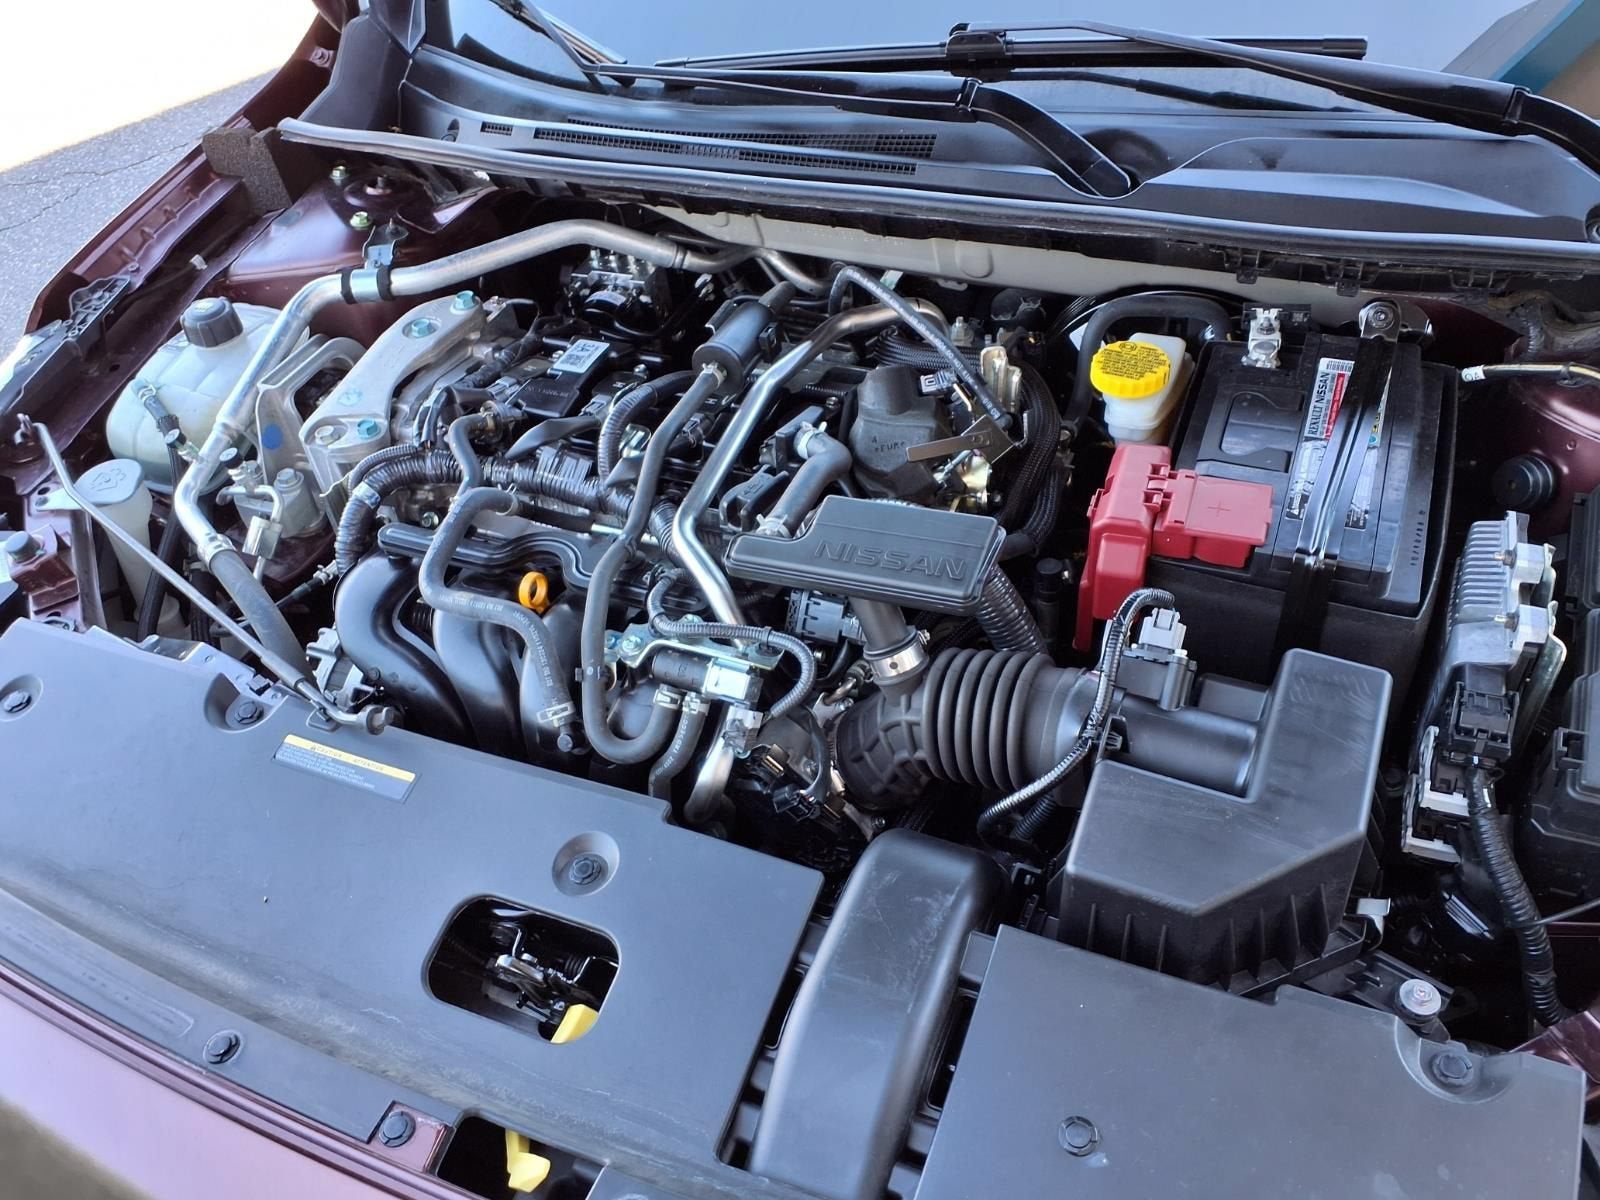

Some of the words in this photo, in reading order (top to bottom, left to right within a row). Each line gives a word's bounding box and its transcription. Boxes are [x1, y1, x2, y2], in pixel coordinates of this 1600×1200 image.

[1315, 372, 1330, 404] NISSAN
[1308, 405, 1323, 435] RENAULT
[814, 540, 968, 581] NISSAN
